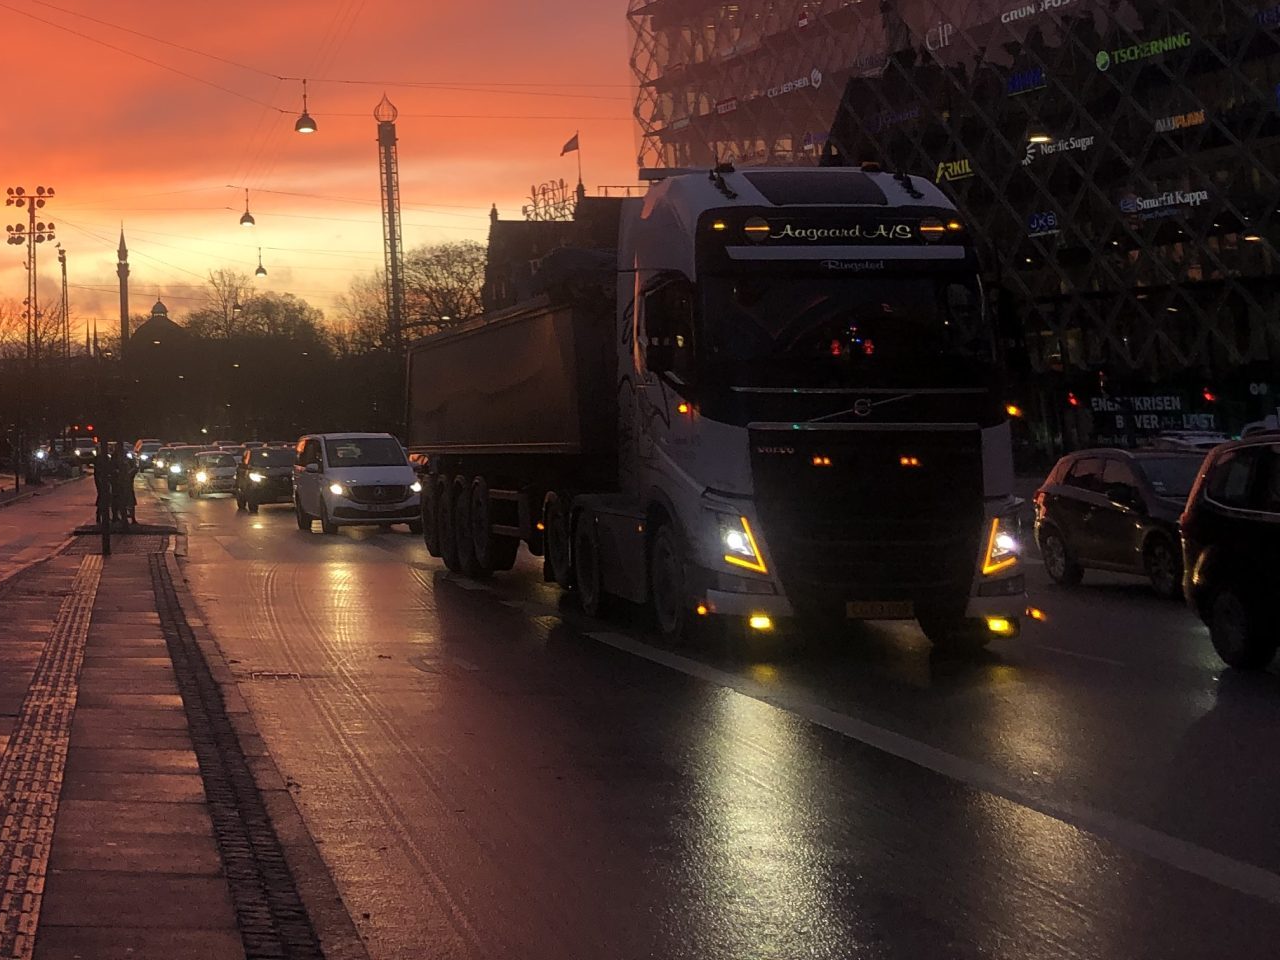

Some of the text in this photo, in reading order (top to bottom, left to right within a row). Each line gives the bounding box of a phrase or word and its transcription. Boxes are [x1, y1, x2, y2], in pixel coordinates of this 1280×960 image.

[1069, 136, 1095, 151] Sugar
[1175, 190, 1208, 207] Kappa
[1030, 215, 1056, 229] JKS
[770, 224, 912, 241] Aagaard A/S
[821, 259, 885, 272] Ringsted
